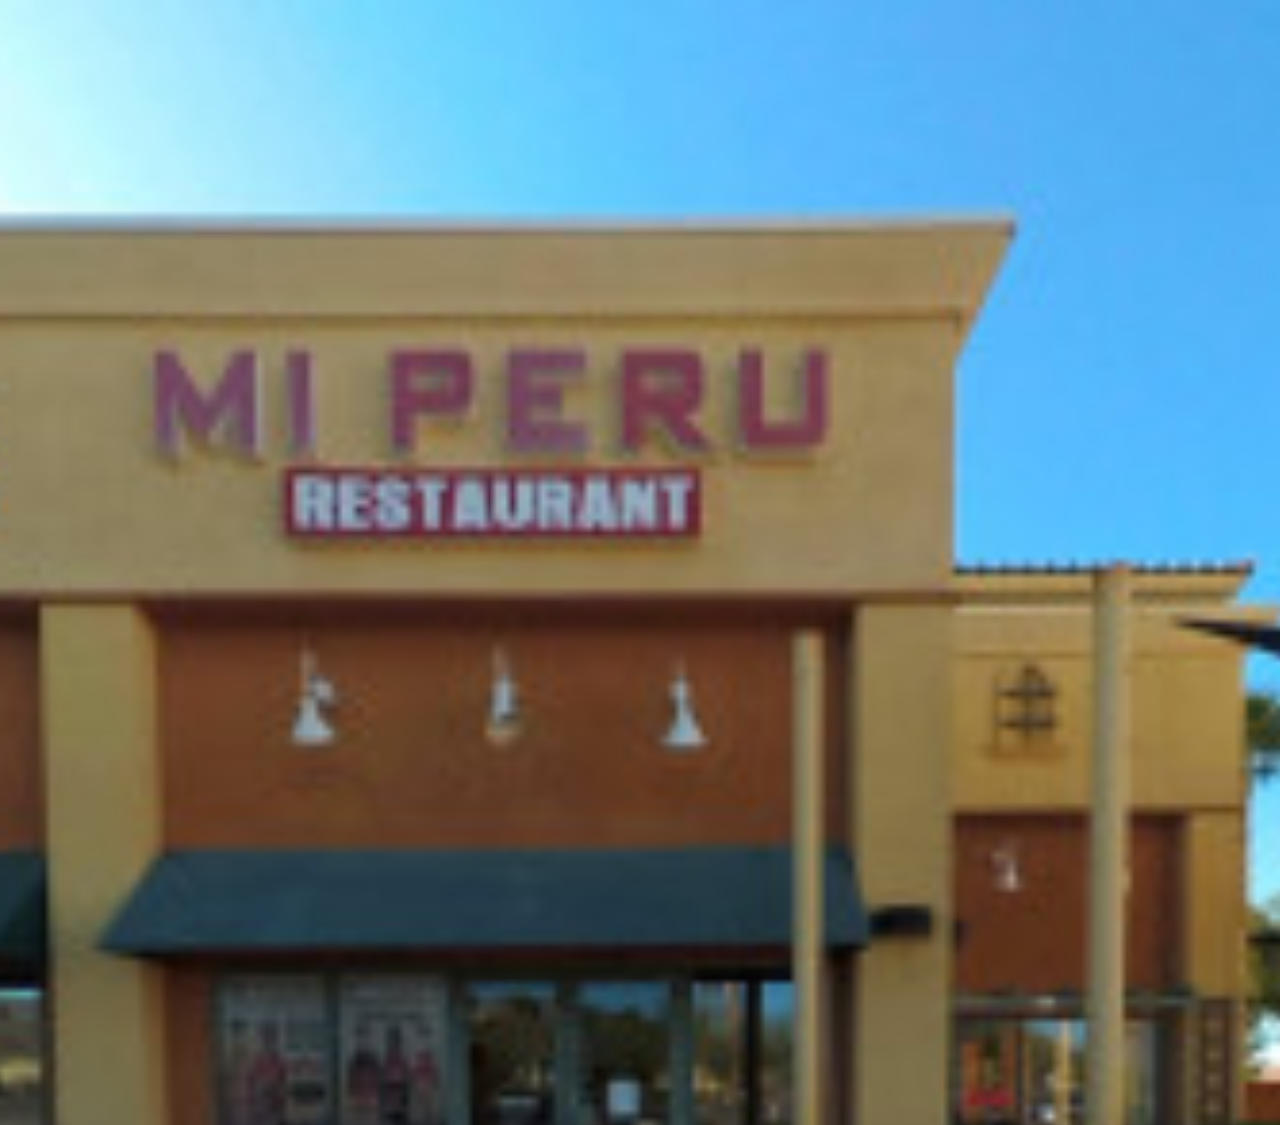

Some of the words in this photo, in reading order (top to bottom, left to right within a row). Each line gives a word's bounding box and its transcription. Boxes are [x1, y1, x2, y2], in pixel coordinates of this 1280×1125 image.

[150, 347, 317, 458] MI
[386, 346, 832, 457] PERU
[291, 474, 694, 532] RESTAURANT
